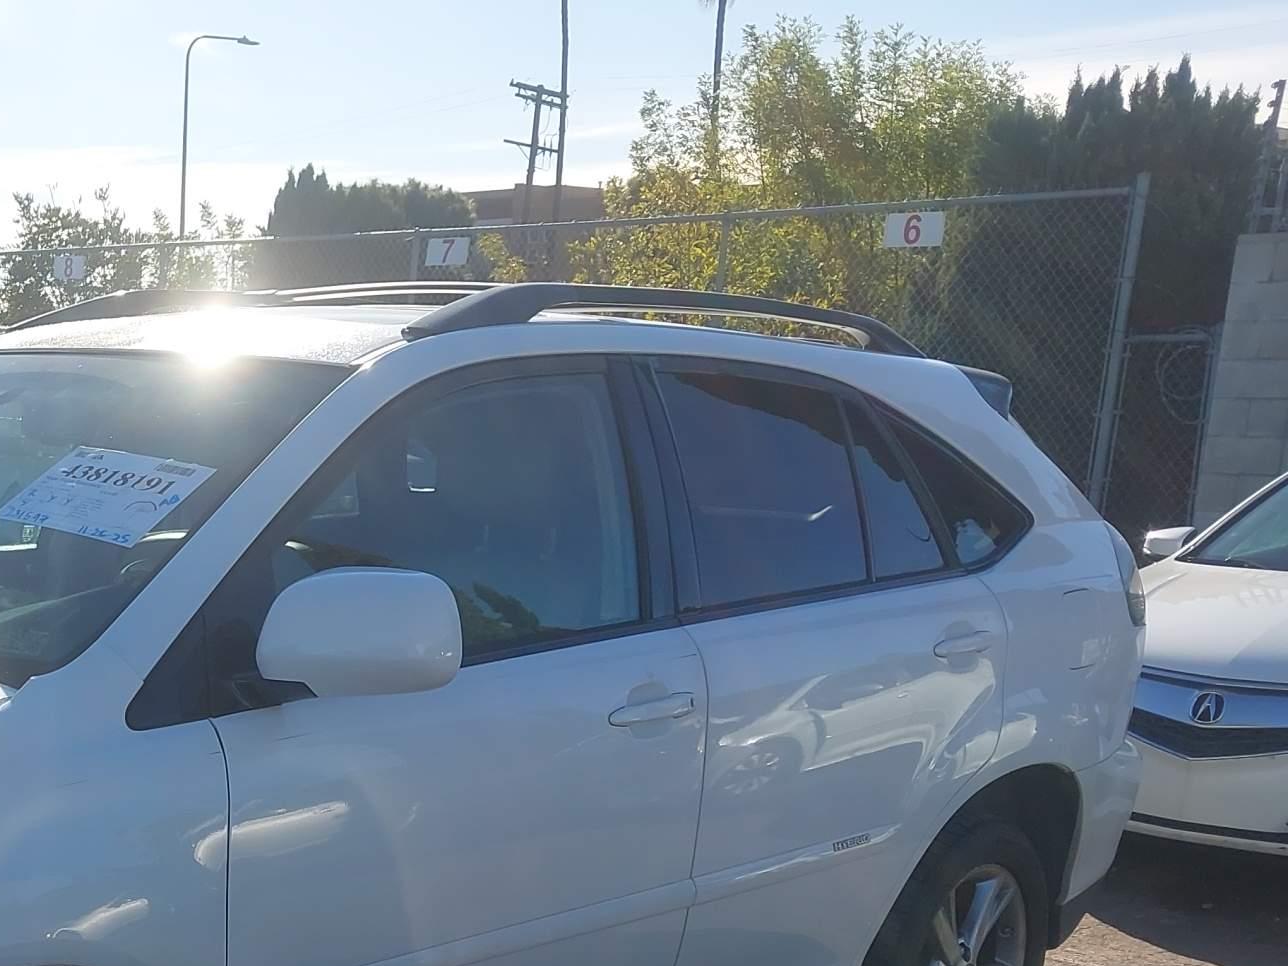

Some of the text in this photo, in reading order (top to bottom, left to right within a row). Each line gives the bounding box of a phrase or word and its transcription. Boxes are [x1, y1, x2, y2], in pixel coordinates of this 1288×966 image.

[903, 214, 922, 246] 6
[442, 239, 456, 264] 7
[64, 257, 73, 278] 8
[61, 464, 176, 496] 43818191
